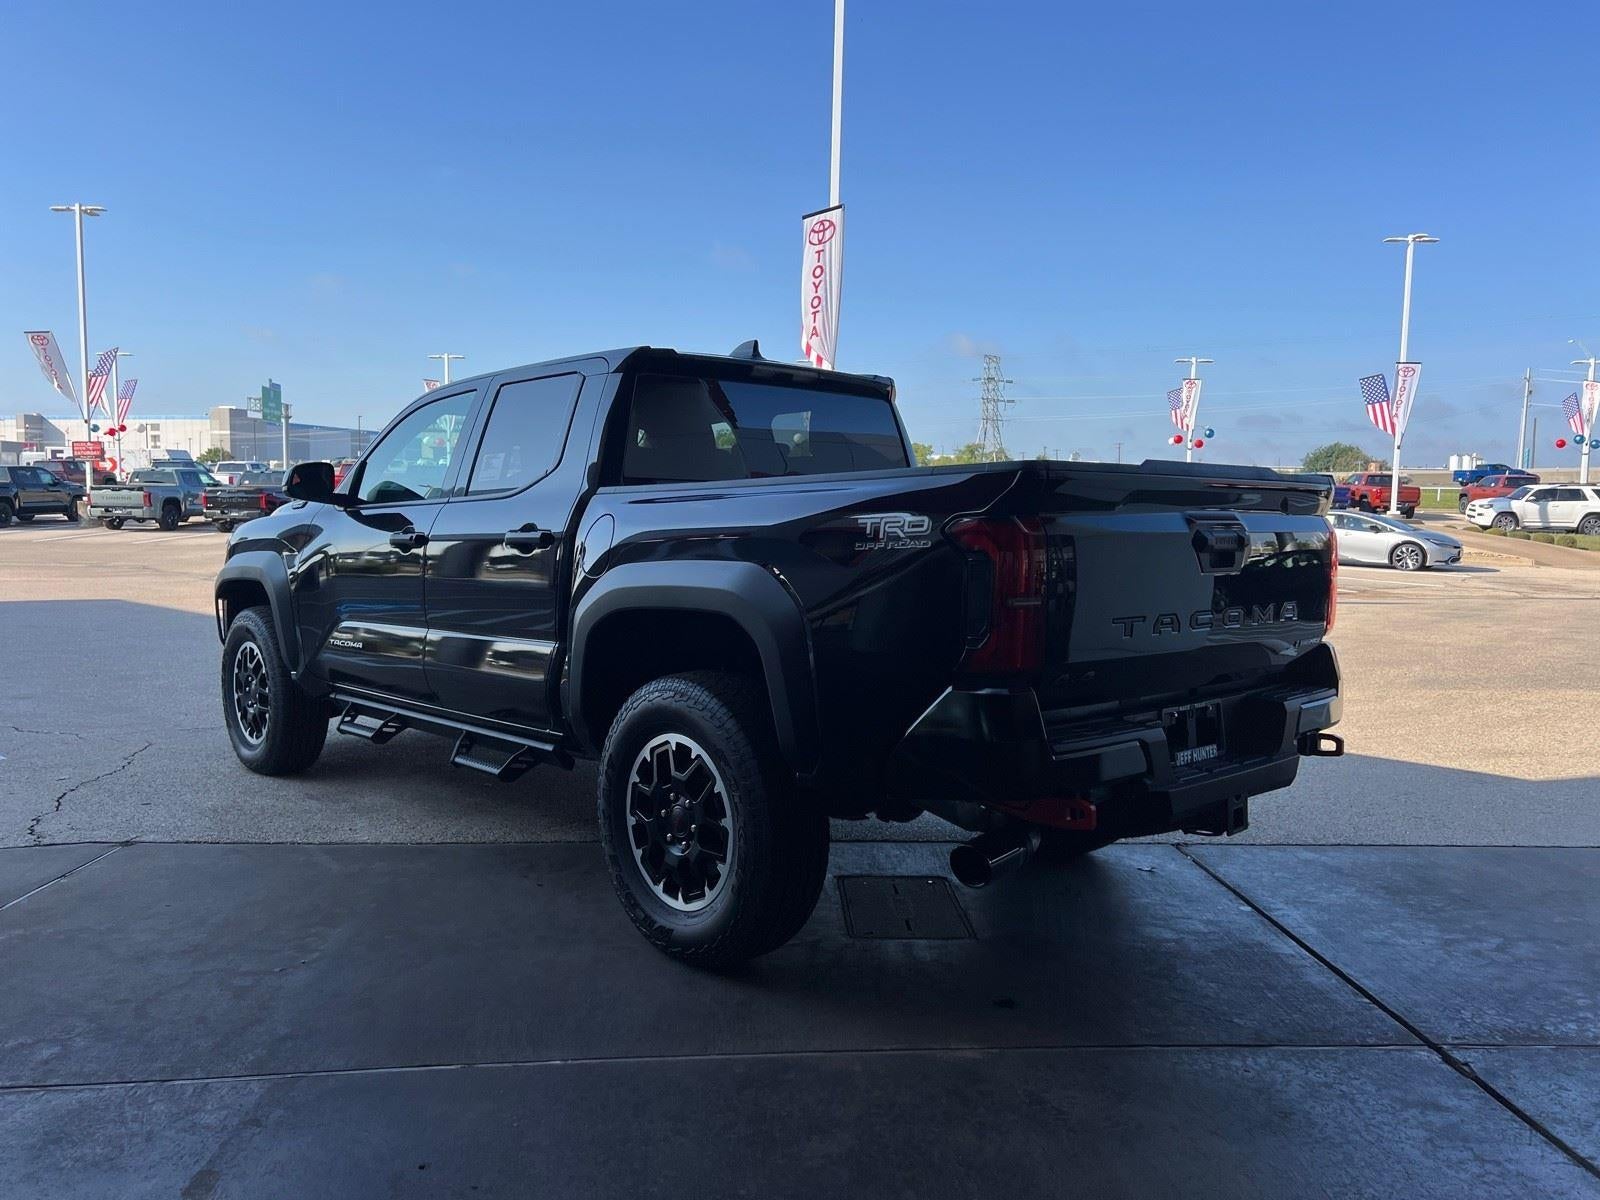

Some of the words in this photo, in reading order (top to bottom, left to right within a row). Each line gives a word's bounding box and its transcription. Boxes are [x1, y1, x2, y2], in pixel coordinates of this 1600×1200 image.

[809, 249, 825, 341] TOYOTA
[1392, 379, 1408, 418] TOYOTA
[855, 513, 932, 541] TRD
[855, 541, 885, 551] OFF
[887, 539, 932, 550] ROAD
[1111, 600, 1299, 639] TACOMA
[329, 639, 363, 649] TACOMA
[1175, 750, 1192, 766] JEFF
[1193, 744, 1218, 763] HUNTER
